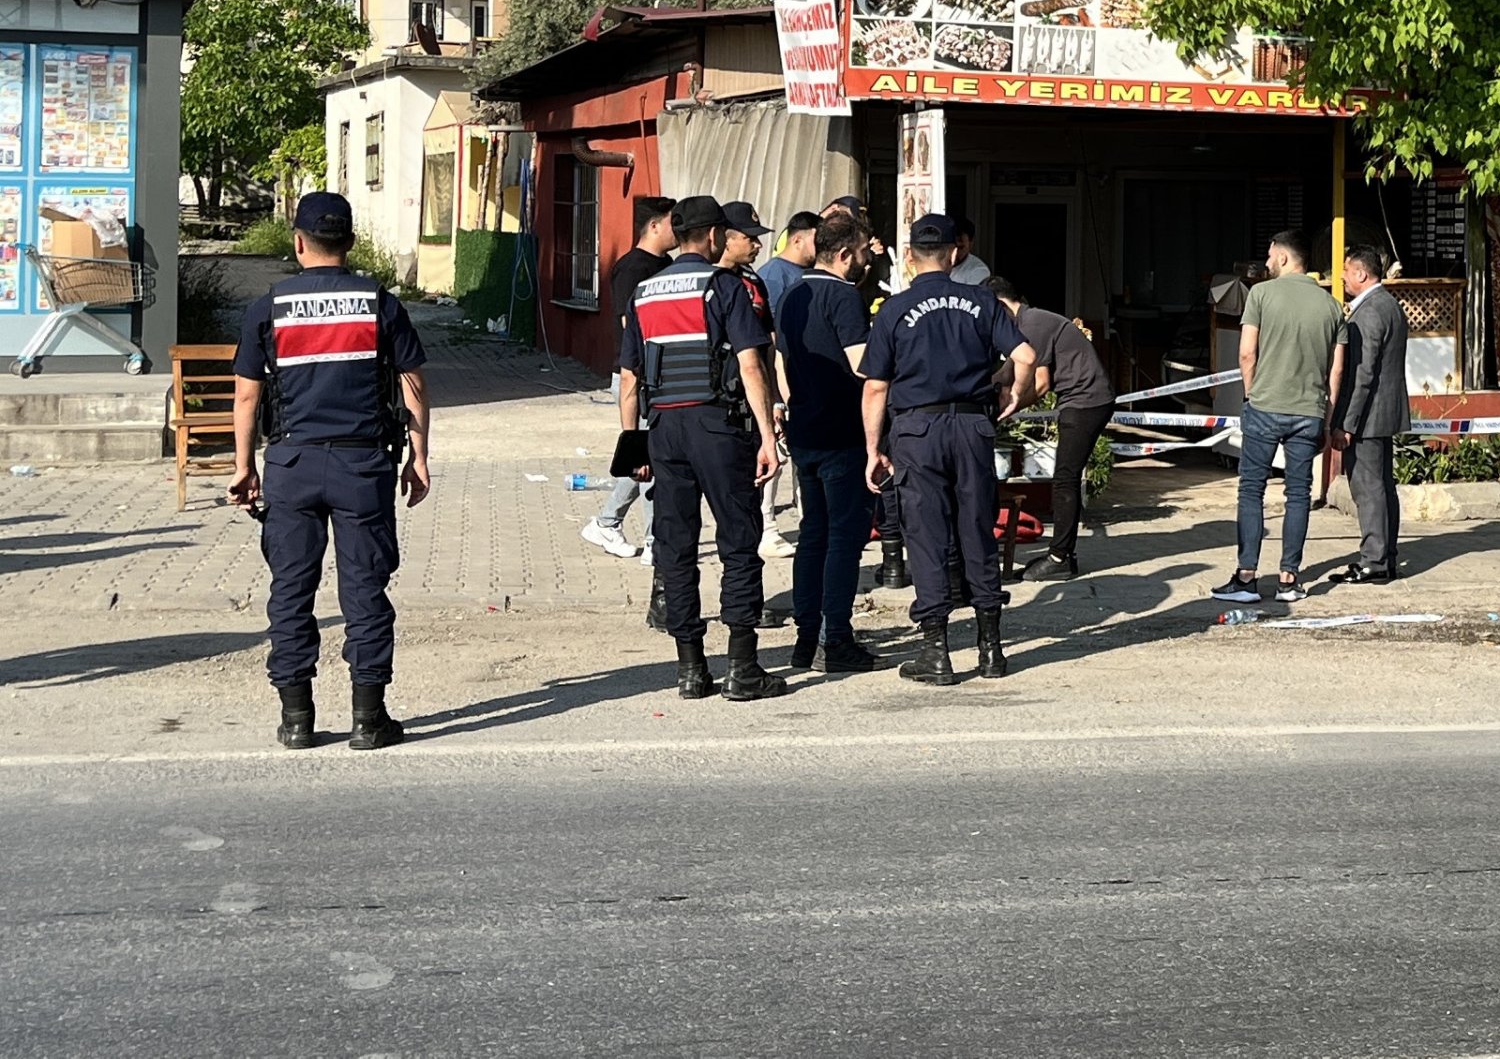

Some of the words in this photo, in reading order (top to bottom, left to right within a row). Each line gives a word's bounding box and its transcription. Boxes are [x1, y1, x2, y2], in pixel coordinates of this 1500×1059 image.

[870, 69, 980, 97] AİLE
[996, 77, 1192, 105] YERİMİZ
[1206, 87, 1370, 112] VARDR
[642, 277, 698, 297] JANDARMA
[286, 298, 371, 318] JANDARMA
[904, 295, 981, 328] JANDARMA
